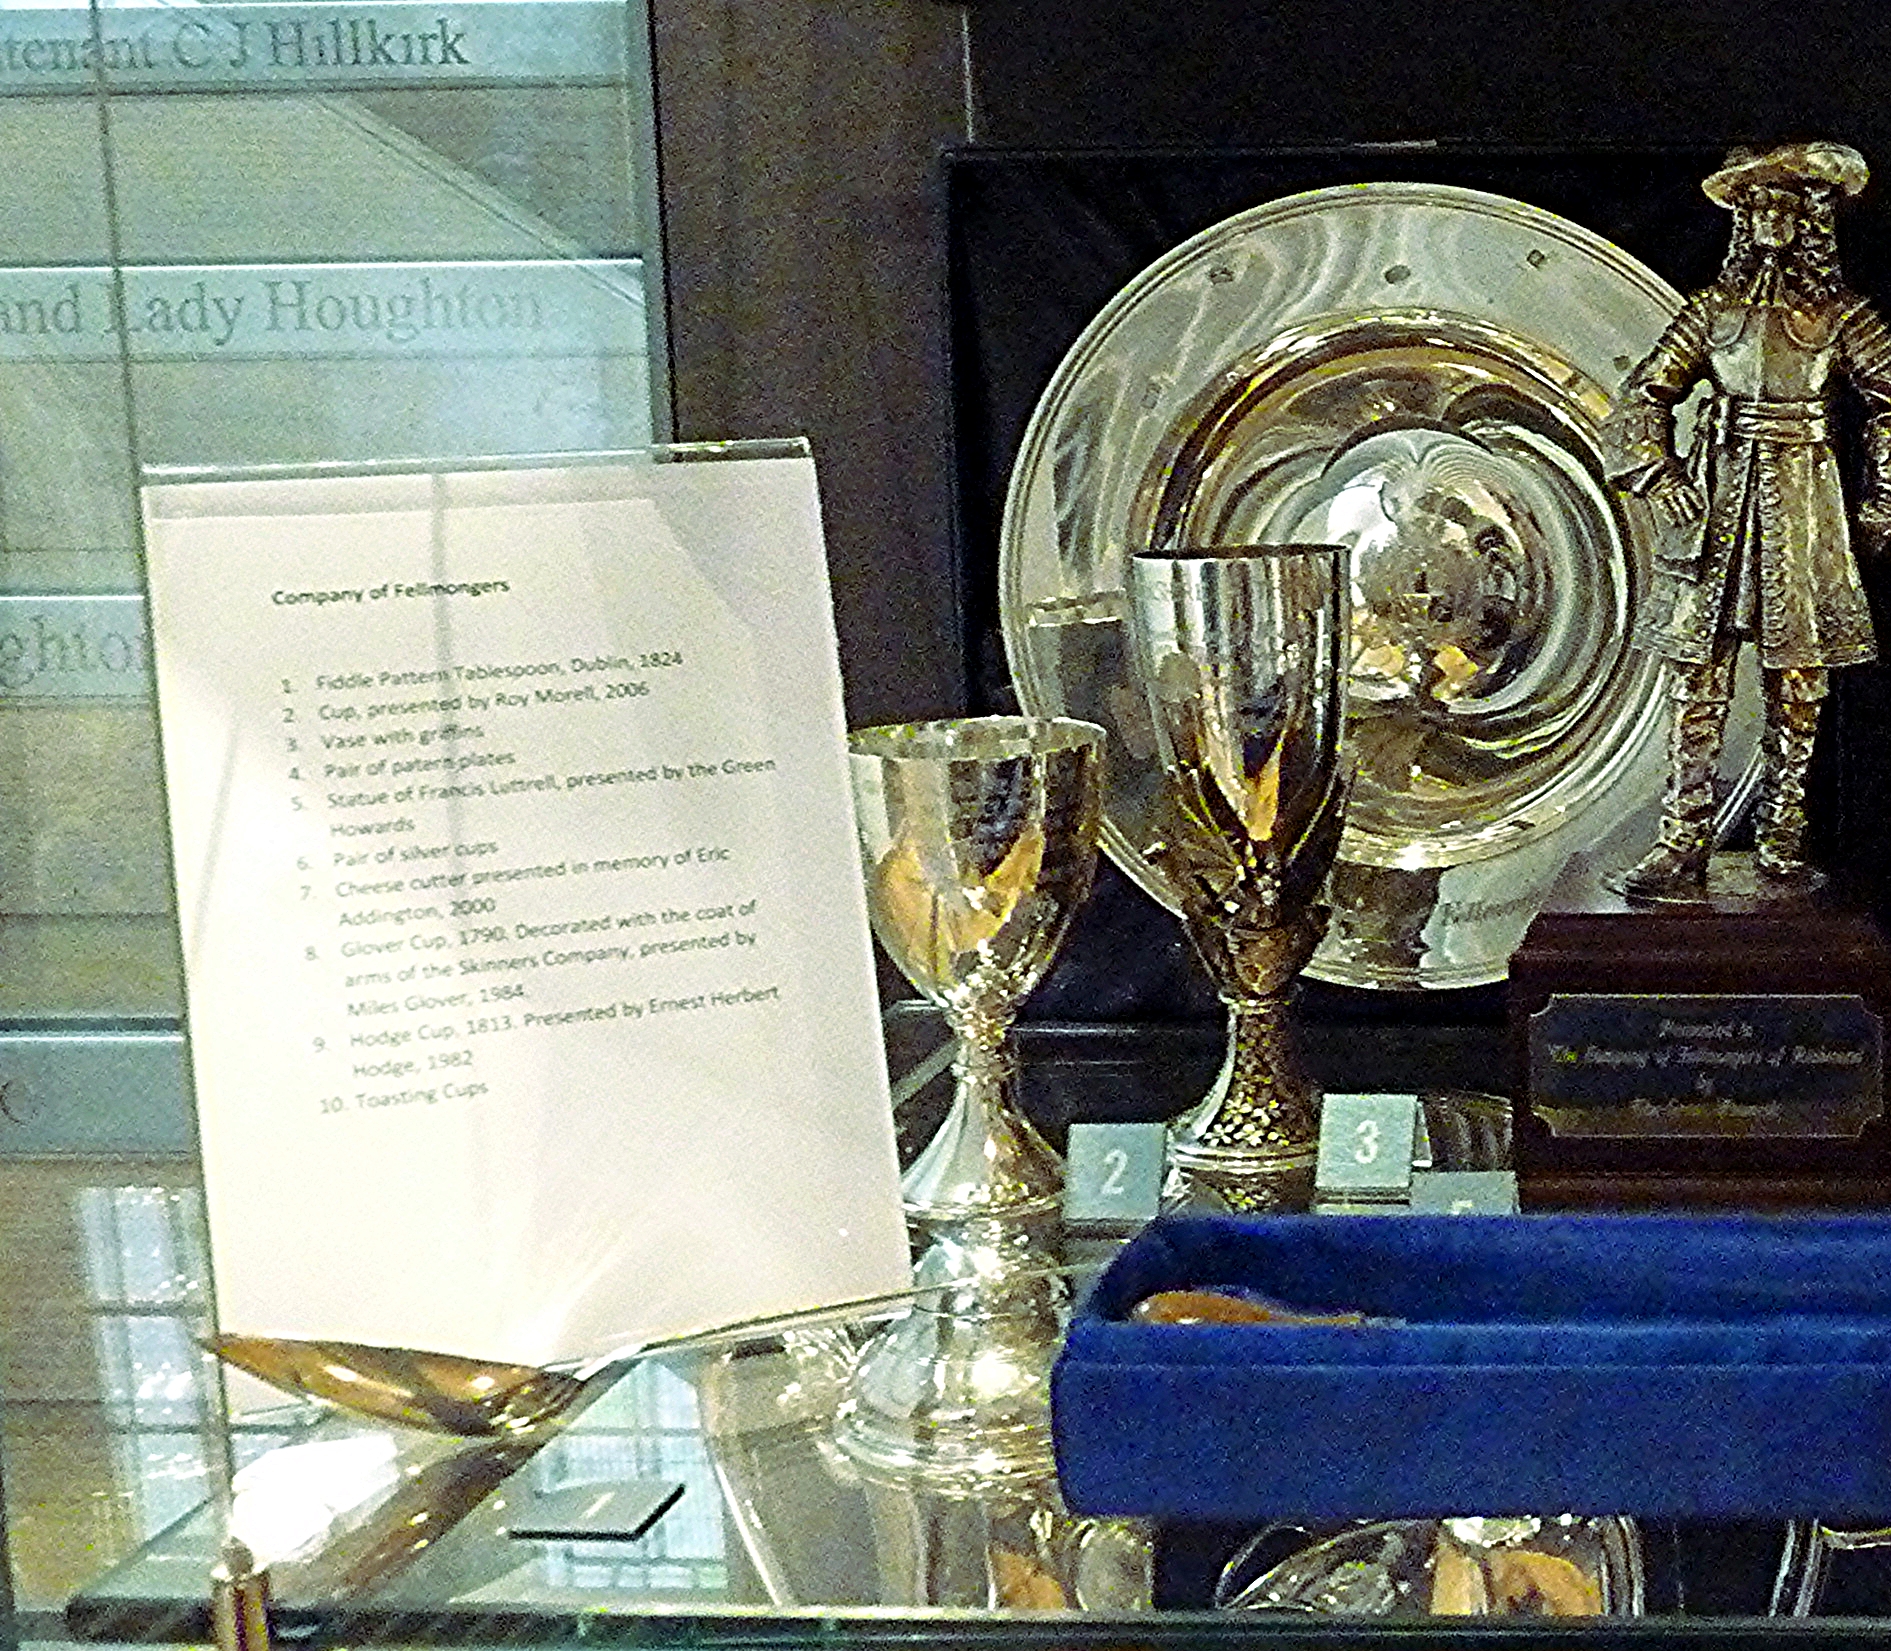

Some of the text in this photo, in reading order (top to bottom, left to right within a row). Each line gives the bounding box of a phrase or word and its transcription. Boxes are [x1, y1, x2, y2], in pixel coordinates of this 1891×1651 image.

[173, 21, 212, 68] C
[228, 20, 251, 68] J
[262, 17, 472, 66] Hillkirk
[99, 281, 244, 346] Lady
[259, 276, 546, 344] Houghton
[271, 580, 510, 606] Company of Fellmongers
[316, 673, 374, 691] Fiddle
[378, 670, 449, 686] Pattern
[454, 662, 566, 682] Tablespoon,
[571, 655, 635, 673] Dublin,
[639, 650, 683, 669] 1824
[367, 697, 462, 719] presented
[467, 695, 490, 712] by
[495, 692, 529, 708] Roy
[535, 684, 599, 703] Morell,
[605, 681, 650, 699] 2006
[320, 735, 366, 750] Vase
[373, 728, 415, 745] with
[420, 723, 485, 747] griffins
[324, 763, 361, 778] Pair
[366, 758, 387, 777] of
[457, 752, 516, 773] plates
[328, 792, 389, 809] Statue
[394, 785, 414, 802] of
[419, 784, 485, 799] Francis
[490, 774, 561, 796] Luttrell,
[567, 768, 658, 791] presented
[661, 764, 684, 782] by
[687, 762, 717, 778] the
[721, 758, 776, 775] Green
[331, 816, 415, 837] Howards
[334, 852, 370, 867] Pair
[375, 845, 395, 863] of
[400, 844, 450, 862] silver
[455, 841, 499, 858] cups
[336, 879, 404, 898] Cheese
[410, 872, 466, 890] cutter
[471, 862, 566, 886] presented
[572, 860, 588, 875] in
[593, 855, 670, 873] memory
[674, 847, 692, 865] of
[696, 846, 731, 863] Eric
[339, 896, 496, 927] Addington, 2000
[341, 939, 404, 958] Glover
[515, 915, 612, 940] Decorated
[616, 910, 657, 930] with
[661, 907, 691, 925] the
[695, 903, 735, 922] coat
[738, 898, 757, 917] of
[345, 929, 758, 988] arms of the Skinners Company, presented by
[347, 999, 400, 1017] Miles
[404, 992, 473, 1012] Glover,
[350, 1030, 412, 1048] Hodge
[523, 1003, 617, 1026] Presented
[621, 1001, 643, 1019] by
[649, 994, 705, 1014] Ernest
[710, 986, 780, 1006] Herbert
[353, 1049, 473, 1078] Hodge, 1982
[355, 1088, 439, 1109] Toasting
[442, 1082, 489, 1101] Cups
[1355, 1118, 1380, 1164] 3
[1101, 1148, 1128, 1196] 2
